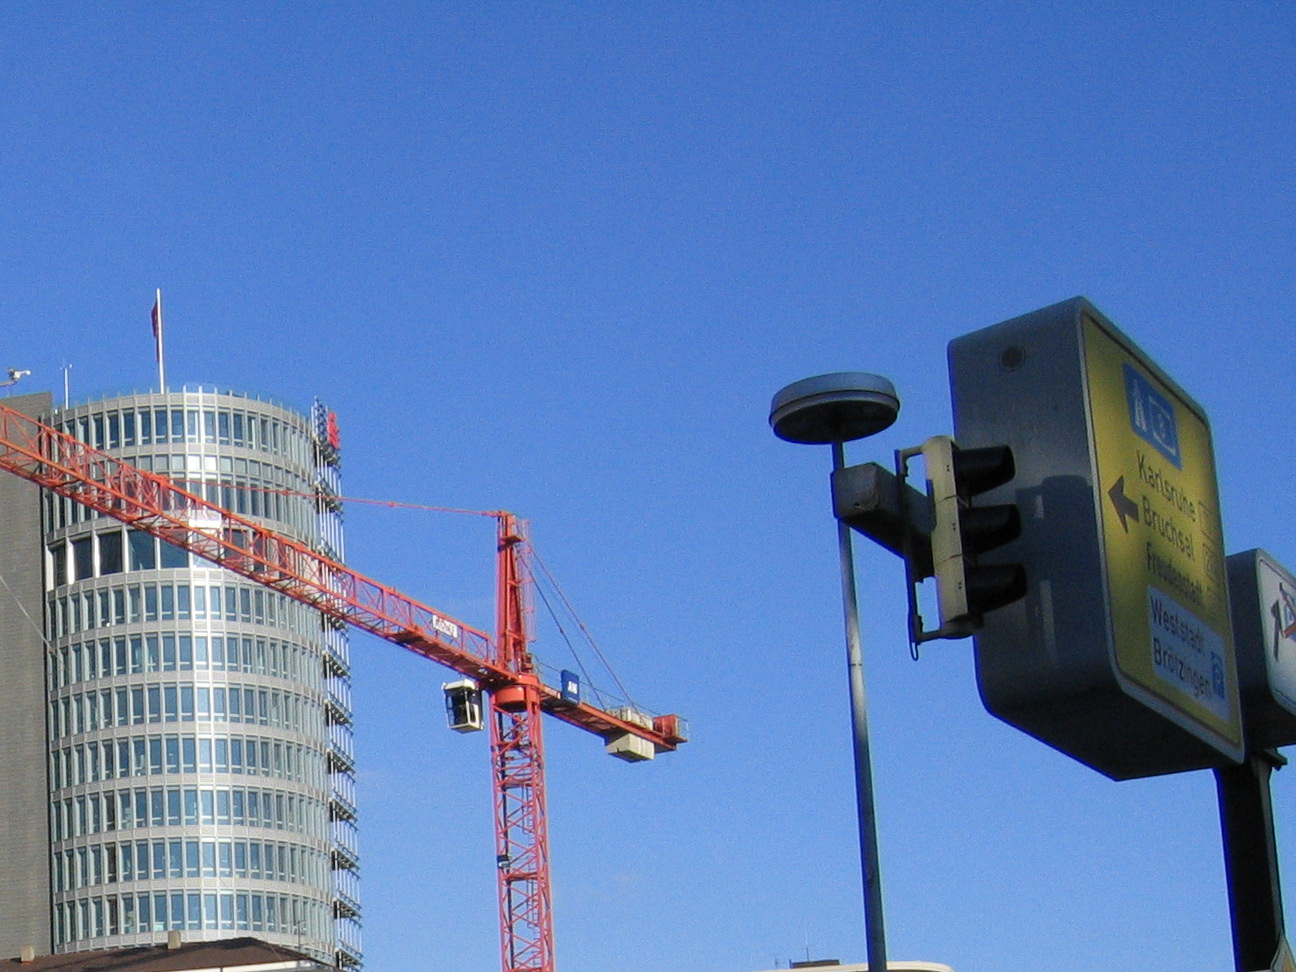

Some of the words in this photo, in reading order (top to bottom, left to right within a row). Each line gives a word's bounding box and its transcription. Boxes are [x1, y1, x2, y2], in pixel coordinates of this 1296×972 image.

[1137, 449, 1196, 523] Karlsruhe
[1141, 494, 1195, 563] Bruchsal
[1150, 596, 1205, 656] Weststadt
